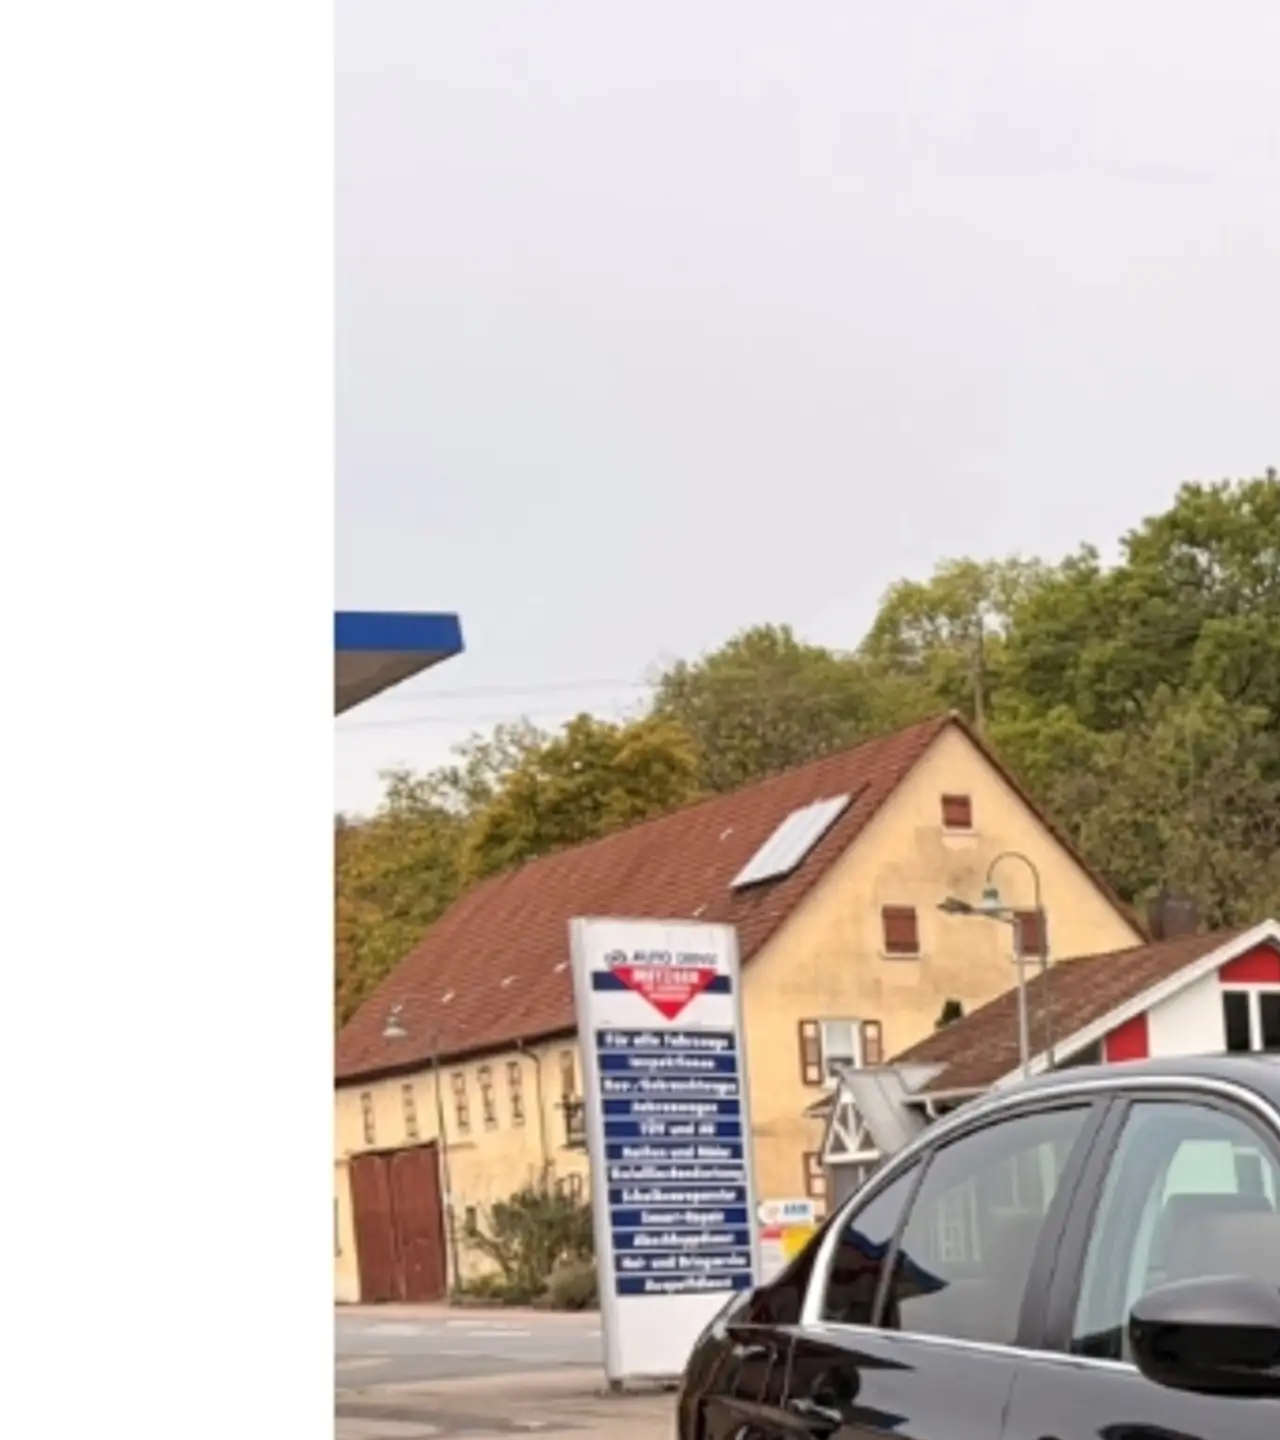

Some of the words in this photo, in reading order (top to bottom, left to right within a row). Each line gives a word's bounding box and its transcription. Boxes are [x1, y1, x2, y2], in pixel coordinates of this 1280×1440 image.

[605, 1033, 629, 1047] Für
[633, 1033, 660, 1047] alle
[669, 1121, 695, 1135] und
[670, 1146, 695, 1159] und
[652, 1254, 677, 1268] und
